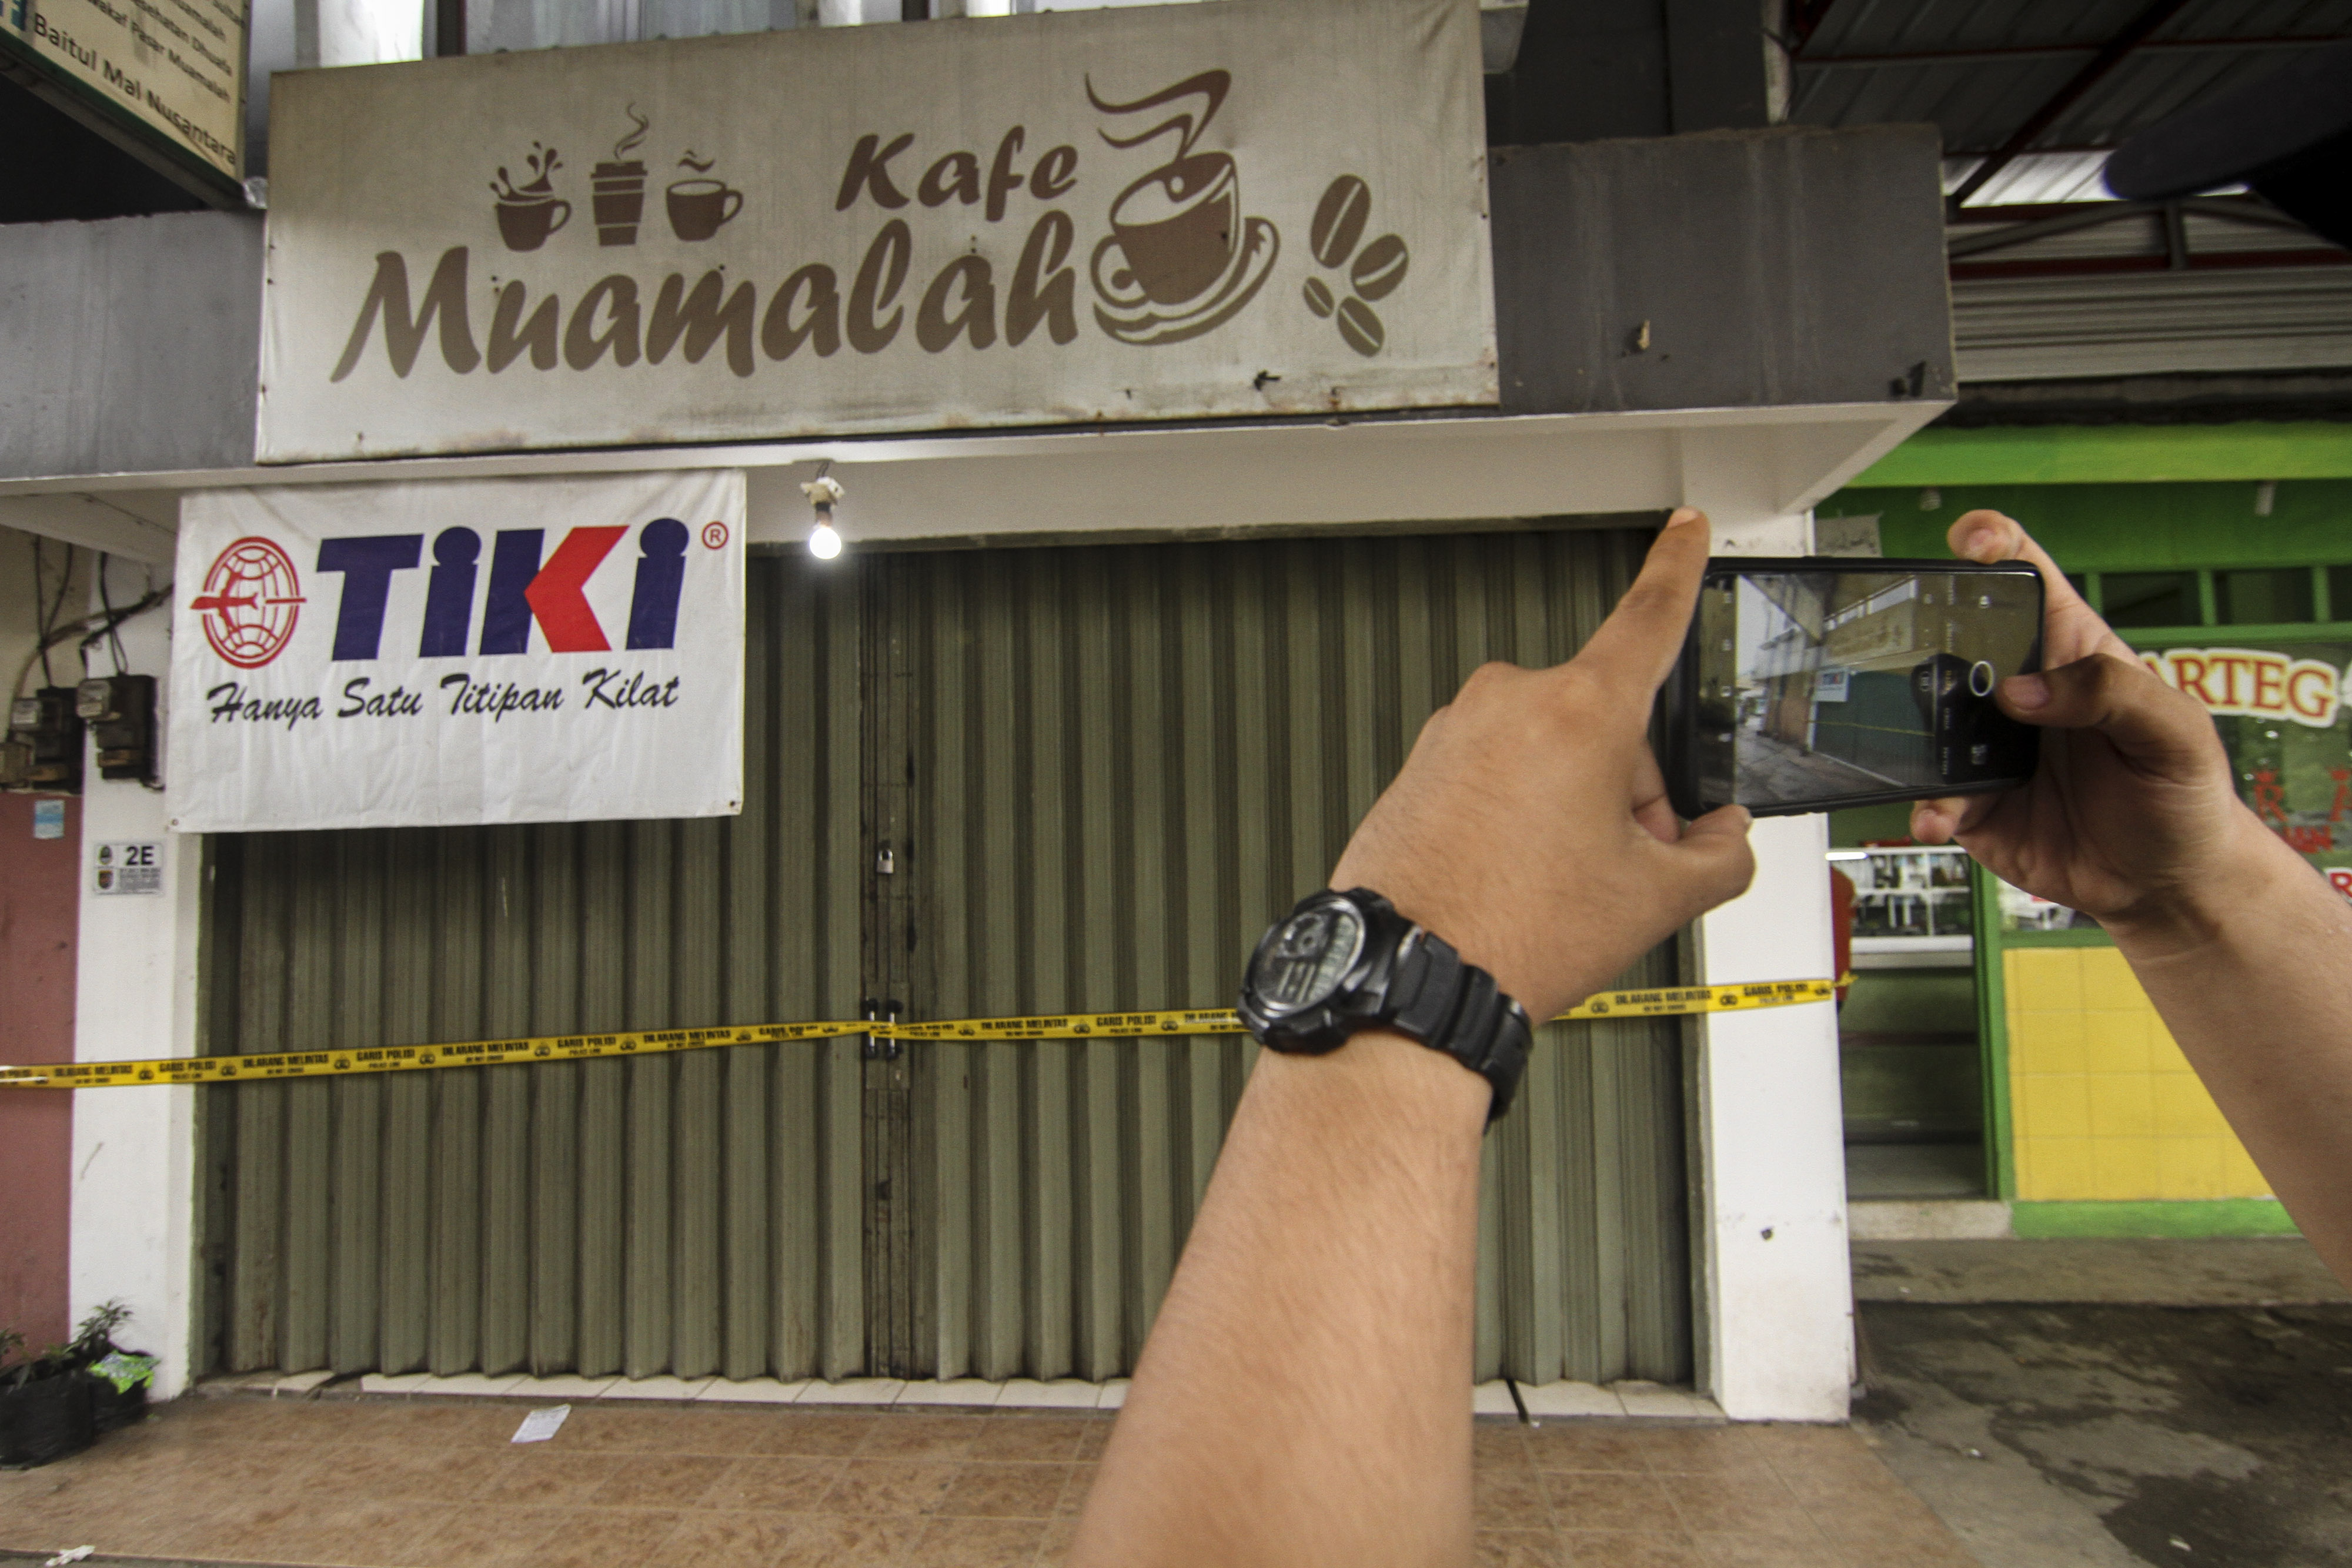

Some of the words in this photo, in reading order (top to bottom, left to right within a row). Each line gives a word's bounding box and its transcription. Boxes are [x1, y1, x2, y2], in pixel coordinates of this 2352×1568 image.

[131, 20, 165, 54] Pasar
[169, 48, 231, 104] Muamalah
[35, 12, 96, 71] Baitul
[103, 59, 142, 101] Mal
[148, 89, 236, 166] Nusantara
[836, 123, 1078, 222] Kafe
[329, 209, 1078, 383] Muamalah
[2146, 657, 2333, 717] RTEG
[206, 681, 323, 730] Hanya
[337, 677, 425, 719] Satu
[439, 673, 564, 724] Titipan
[582, 668, 681, 713] Kilat
[125, 845, 155, 866] 2E
[1026, 1018, 1068, 1029] MELINTAS
[1096, 1017, 1124, 1027] GARIS
[1127, 1015, 1157, 1025] POLISI
[557, 1037, 584, 1048] GARIS
[587, 1035, 616, 1047] POLISI
[689, 1029, 731, 1041] MELINTAS
[487, 1041, 529, 1052] MELINTAS
[288, 1054, 329, 1065] MELINTAS
[356, 1051, 383, 1062] GARIS
[386, 1048, 416, 1060] POLISI
[159, 1063, 185, 1072] GARIS
[188, 1061, 216, 1071] POLISI
